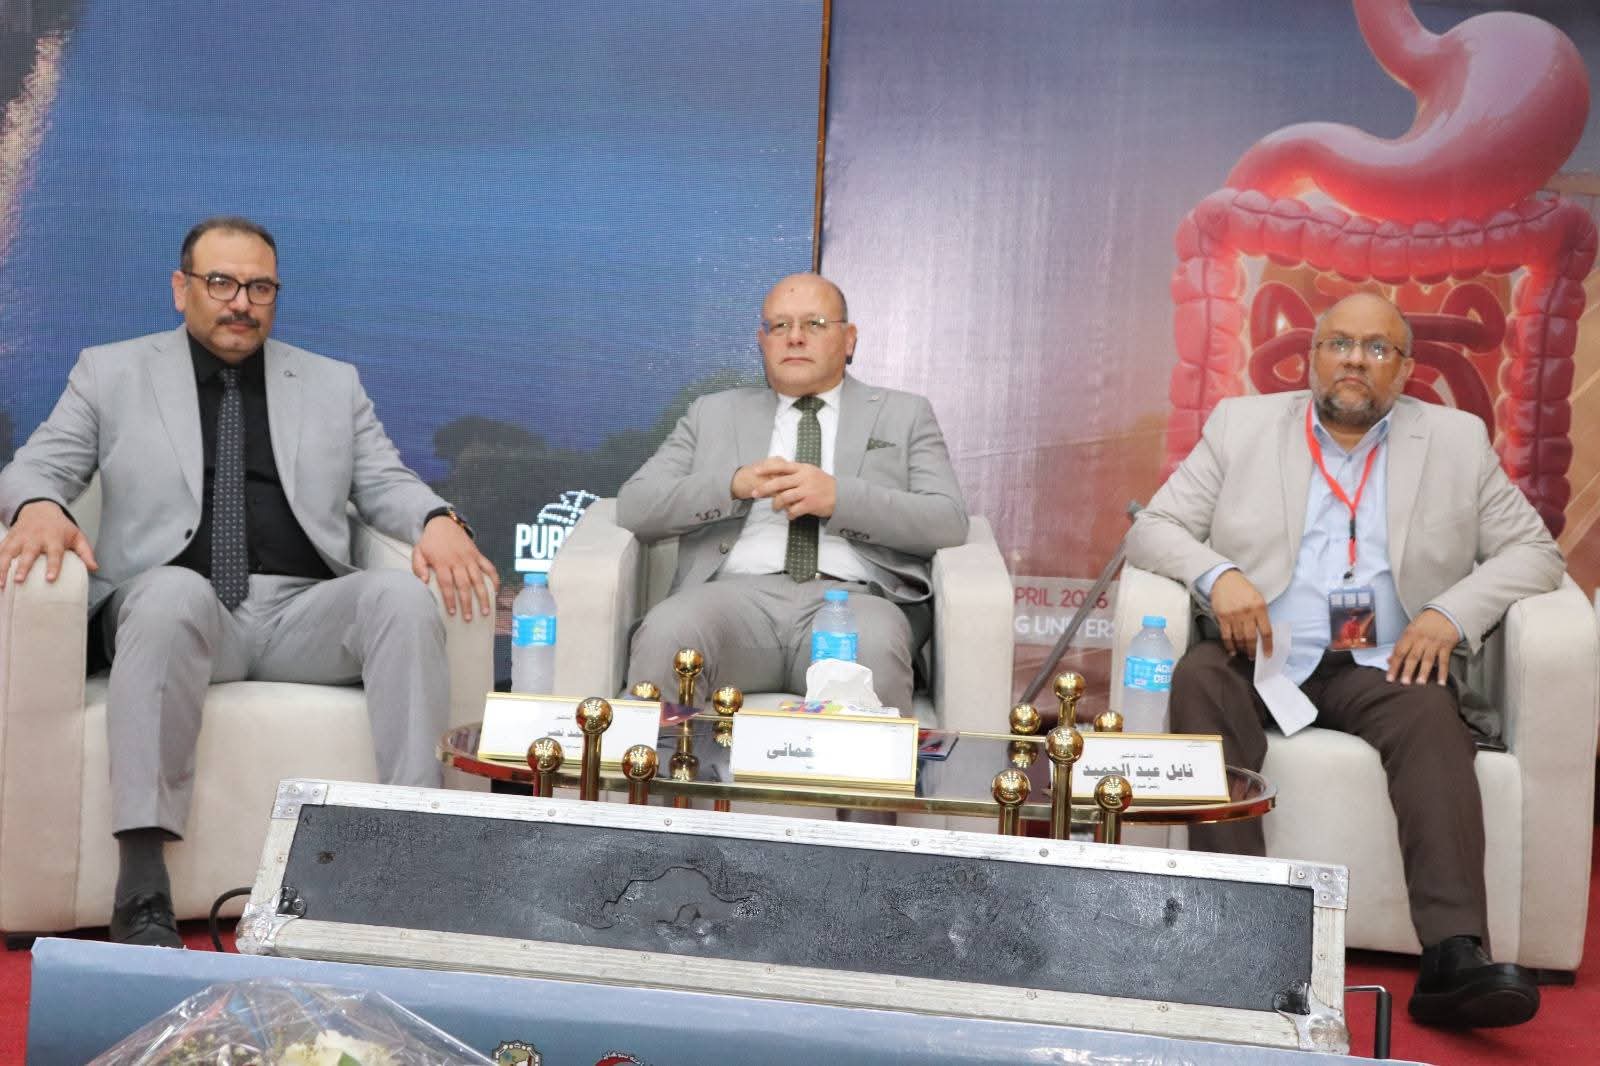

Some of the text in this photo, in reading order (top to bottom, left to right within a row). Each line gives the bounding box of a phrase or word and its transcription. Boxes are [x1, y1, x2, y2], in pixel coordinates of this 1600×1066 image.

[515, 523, 574, 558] PUR
[1014, 586, 1109, 609] PRIL 206
[1035, 615, 1114, 638] UNER
[1083, 762, 1194, 780] نايل عبد الحميد
